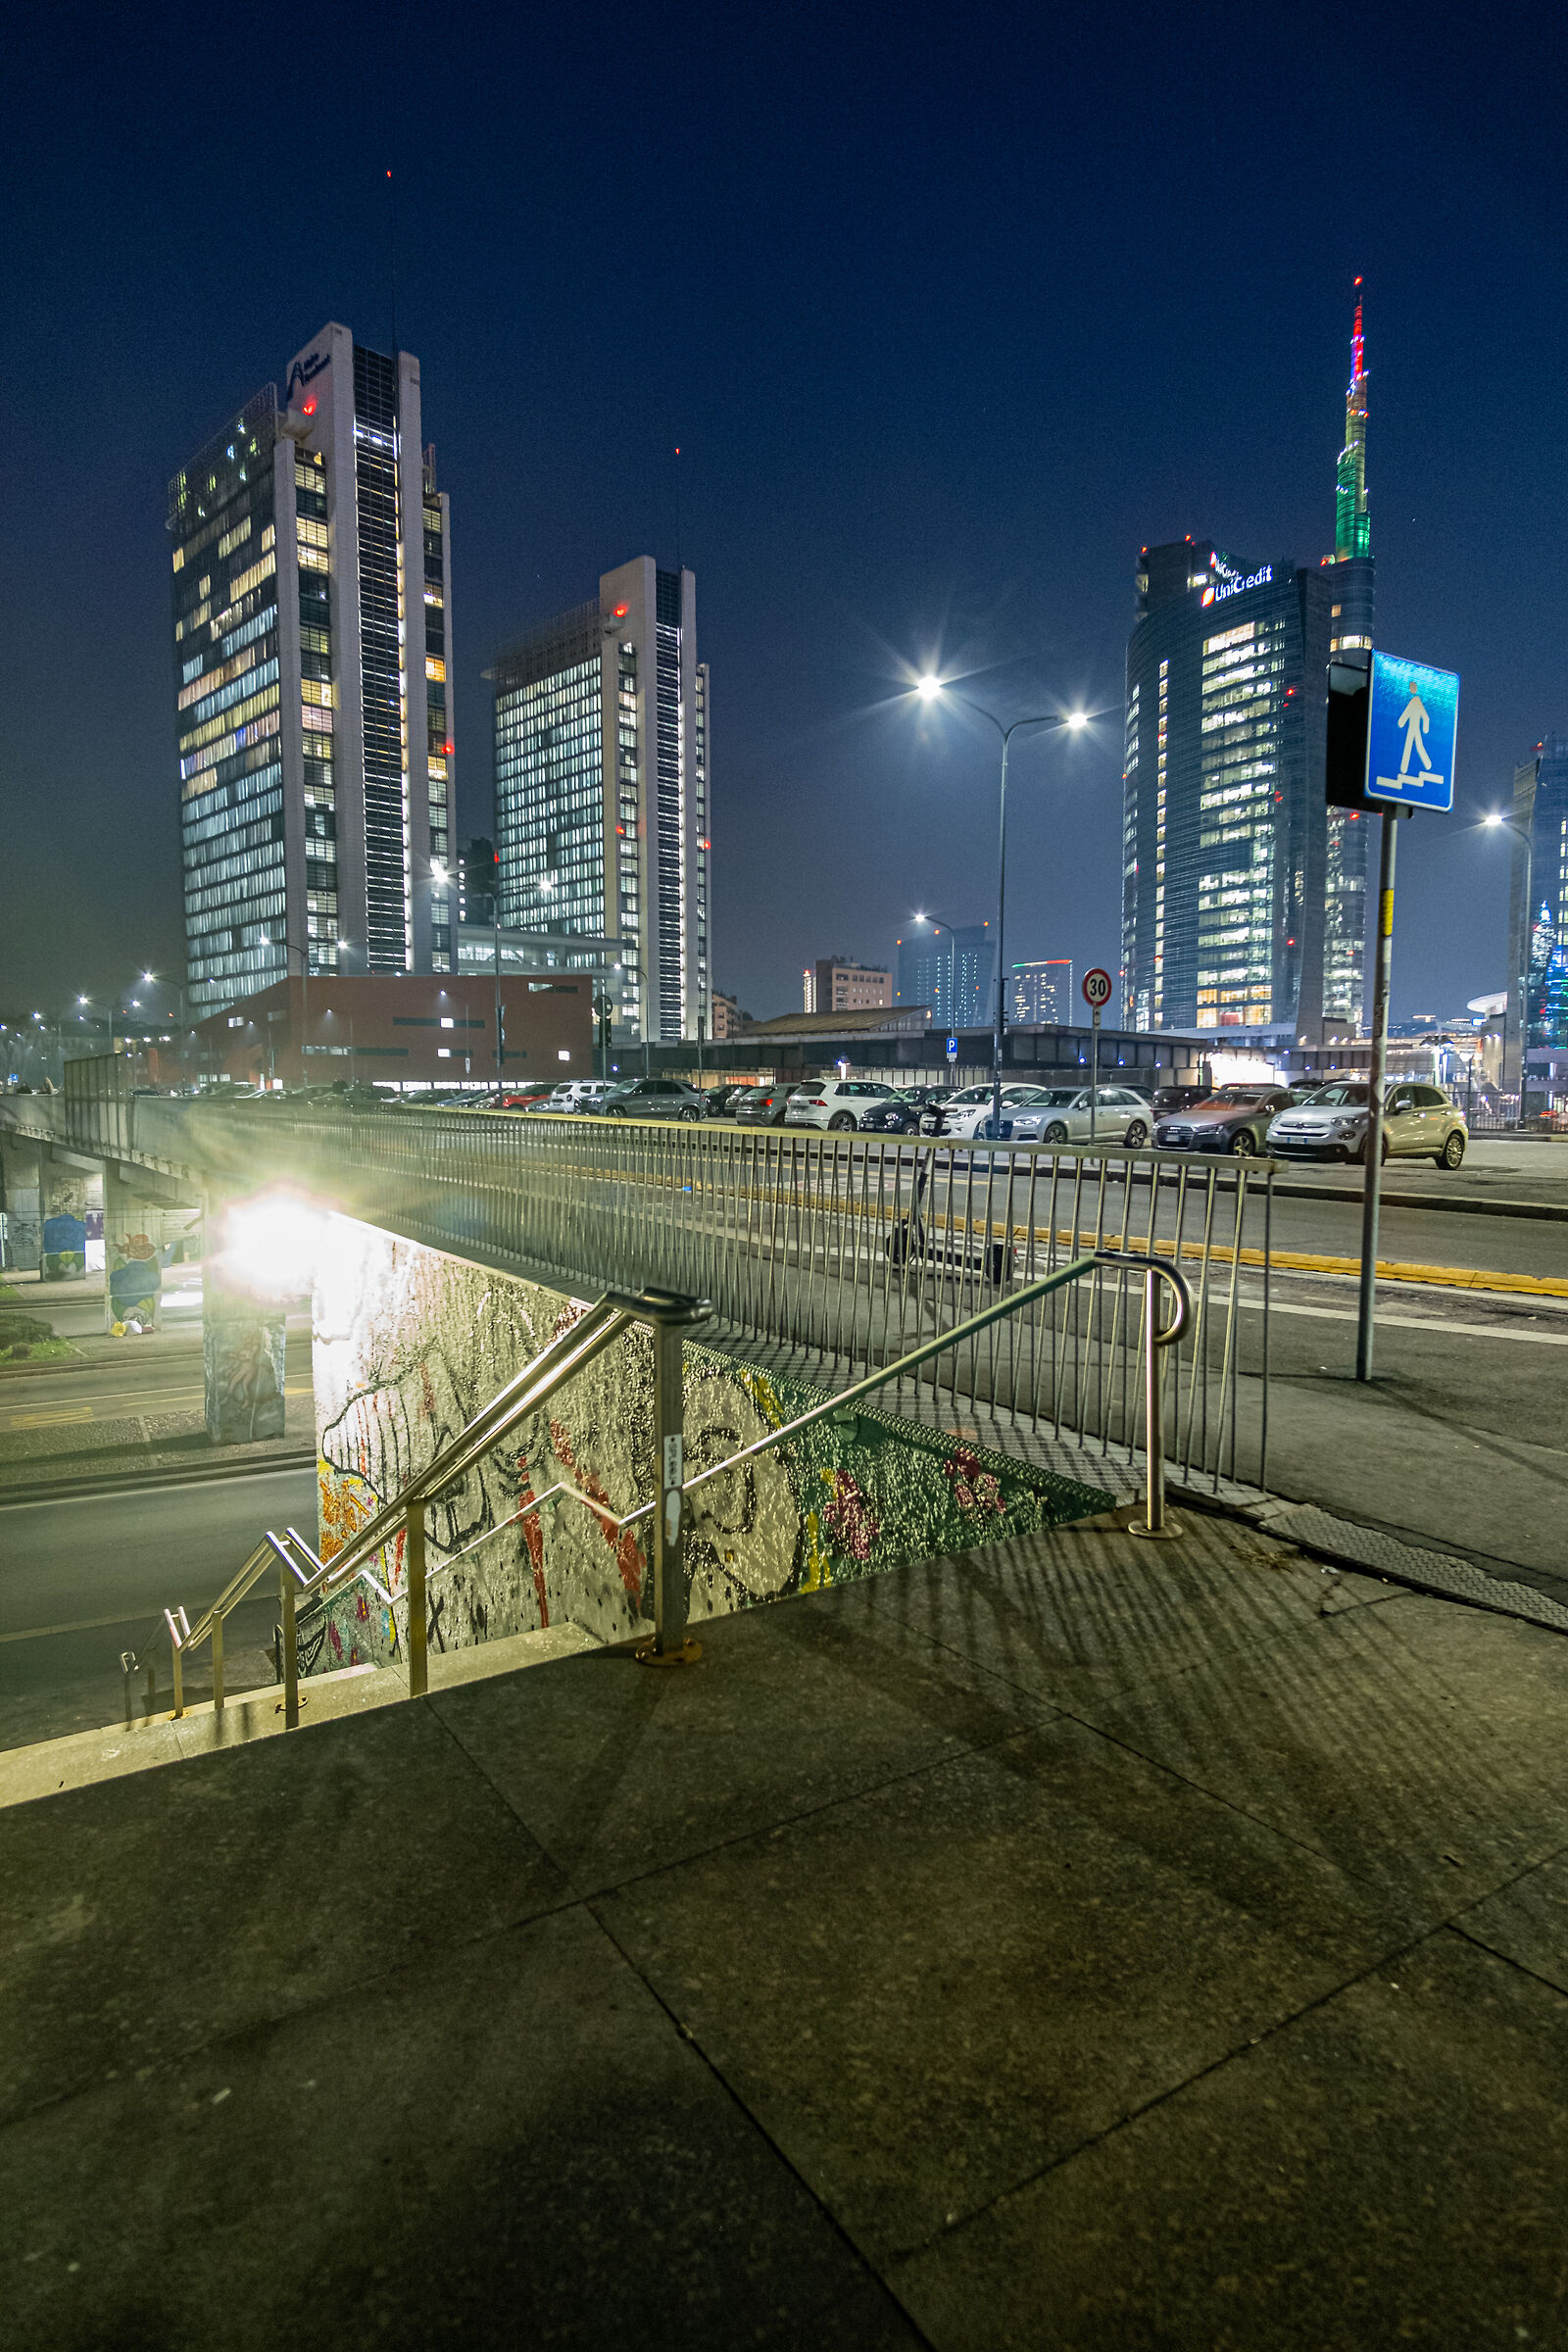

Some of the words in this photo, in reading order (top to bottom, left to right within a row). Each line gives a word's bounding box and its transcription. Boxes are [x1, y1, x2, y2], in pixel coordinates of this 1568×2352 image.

[1215, 564, 1273, 602] UniCredit
[1089, 978, 1106, 997] 30
[948, 1040, 956, 1052] P
